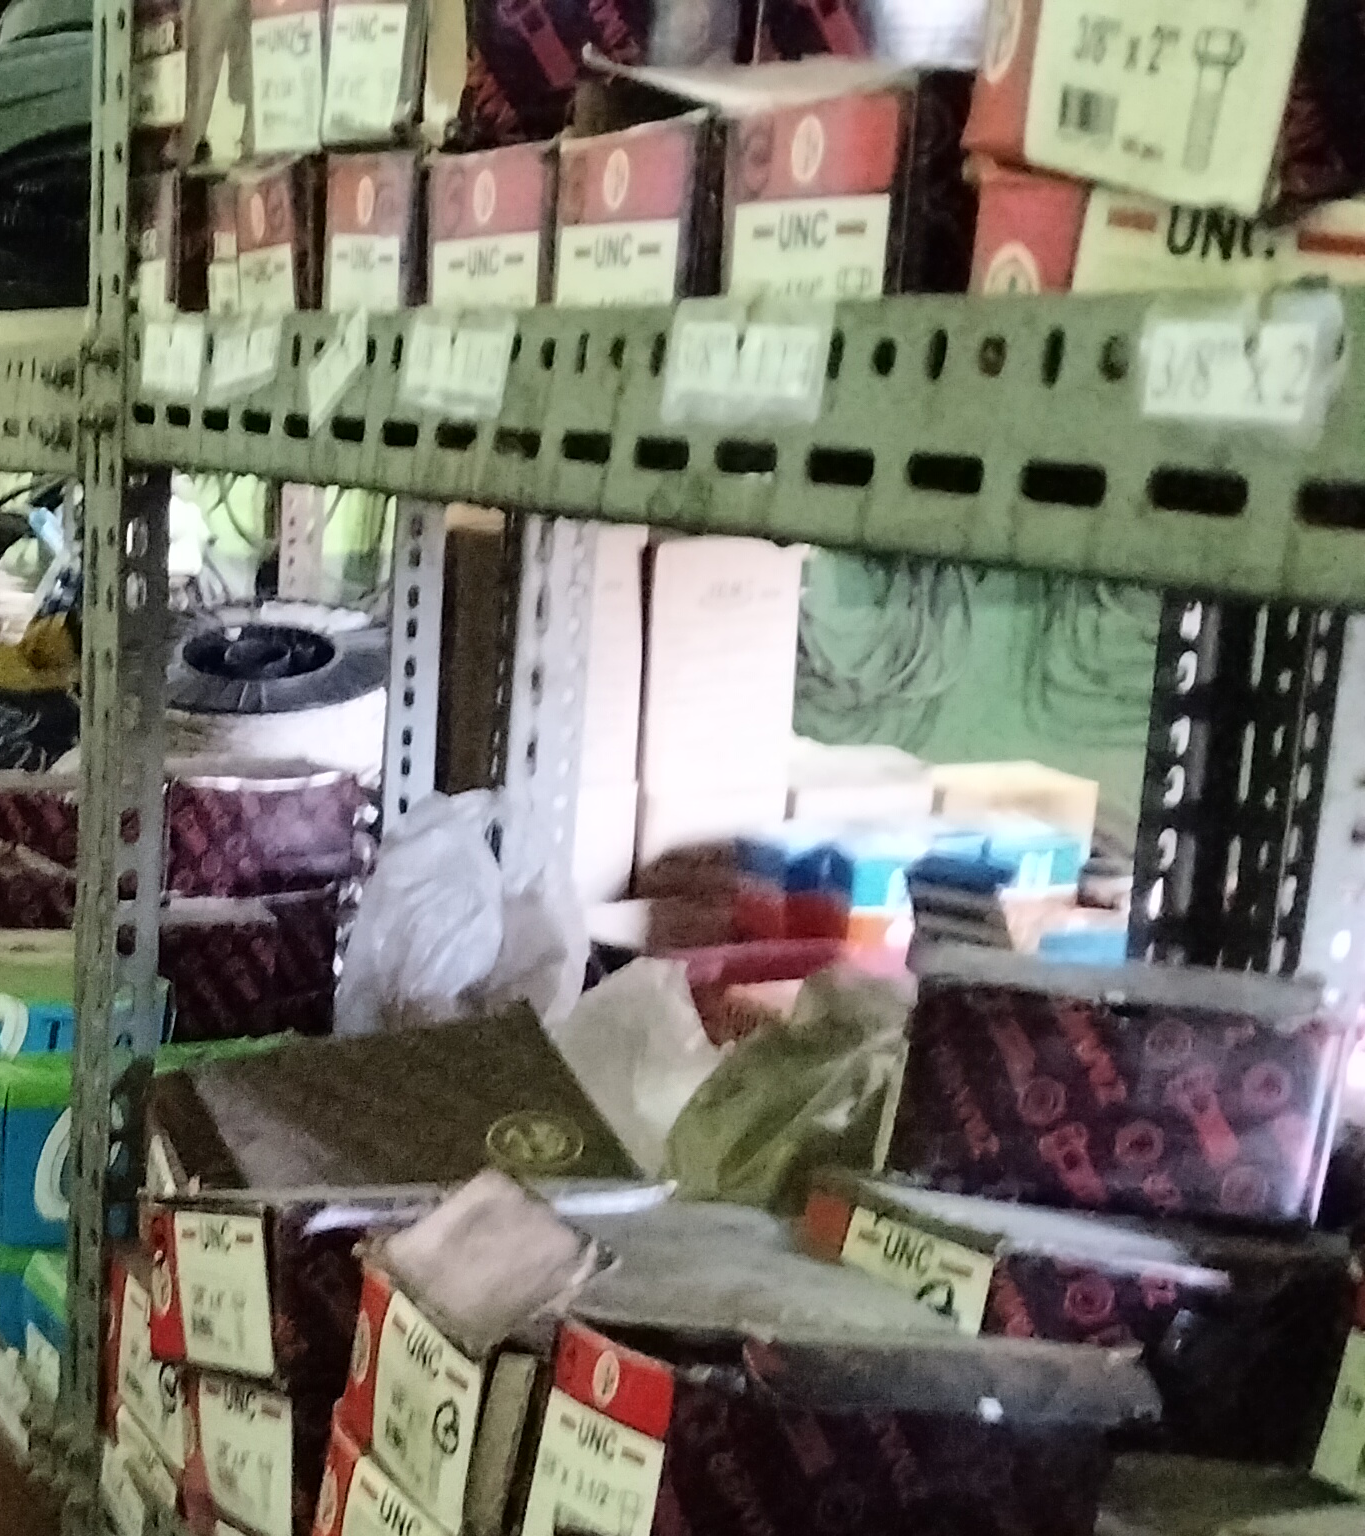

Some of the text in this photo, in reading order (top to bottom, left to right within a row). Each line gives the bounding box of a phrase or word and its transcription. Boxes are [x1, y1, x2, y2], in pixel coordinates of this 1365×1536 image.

[594, 232, 632, 268] UNC
[777, 209, 829, 250] UNC
[468, 246, 500, 279] UNC
[885, 1220, 935, 1278] UNC
[407, 1321, 444, 1378] UNC
[578, 1416, 618, 1462] UNC
